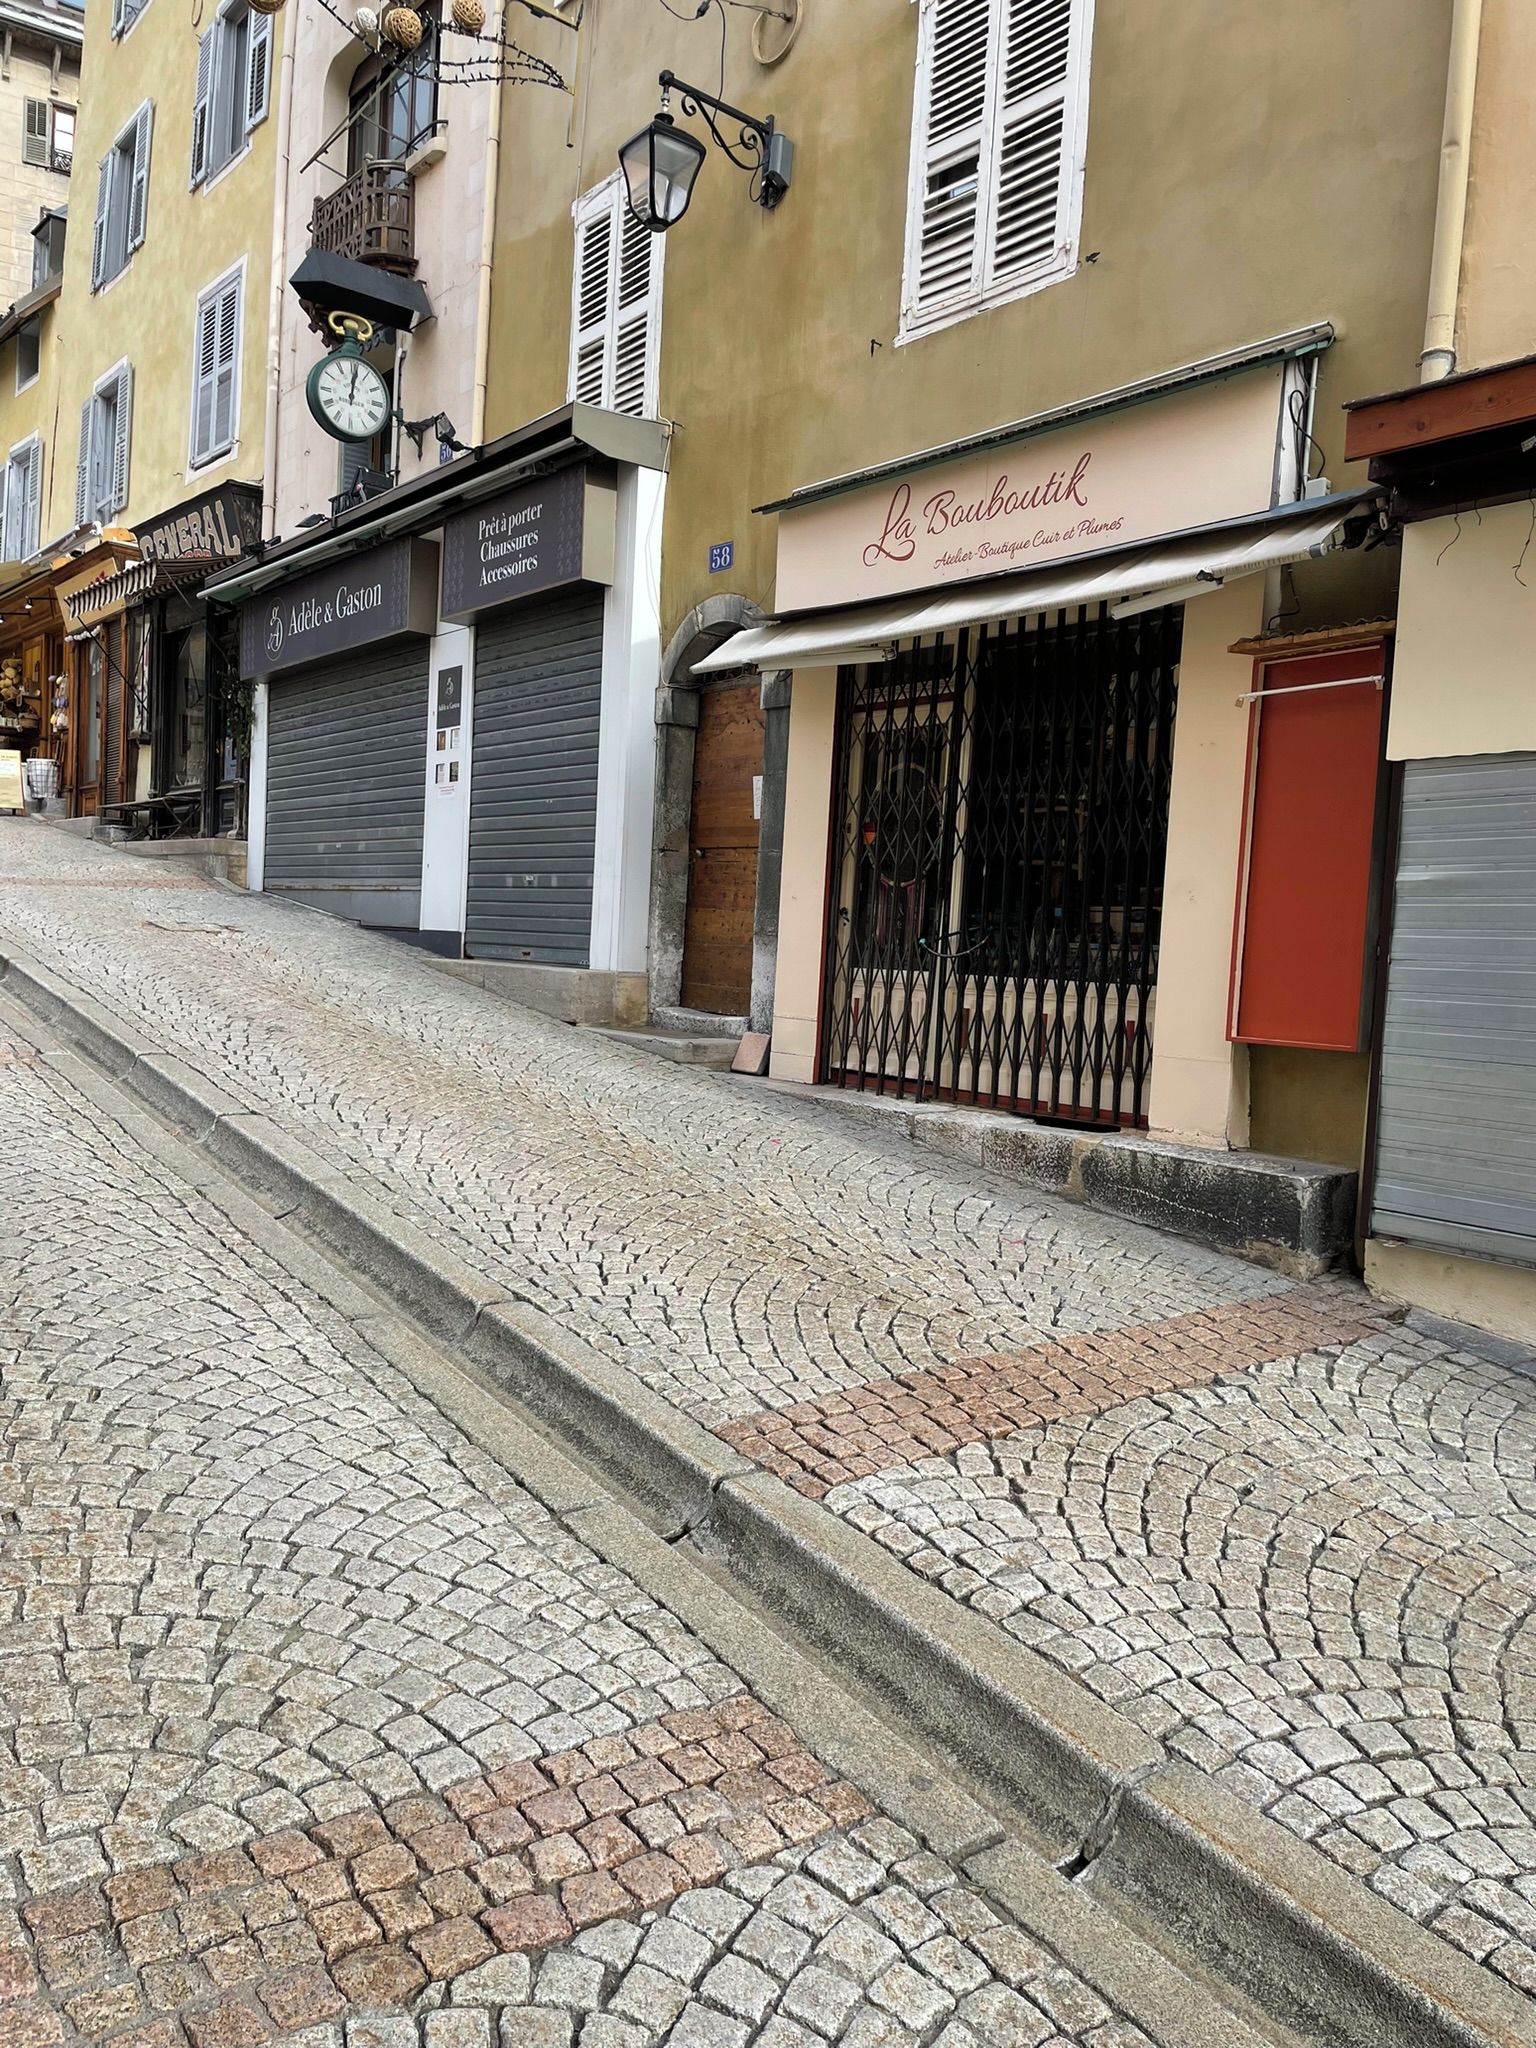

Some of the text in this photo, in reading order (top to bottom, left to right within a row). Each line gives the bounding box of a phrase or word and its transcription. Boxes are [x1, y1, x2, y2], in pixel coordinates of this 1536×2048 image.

[479, 517, 500, 541] Prêt
[508, 504, 543, 532] porter
[862, 452, 1092, 567] La Bouboutik
[480, 530, 539, 563] Chaussures
[1032, 530, 1060, 548] Cuir
[1059, 526, 1075, 542] et
[1077, 516, 1124, 538] Plumes
[479, 553, 538, 587] Accessoires
[711, 546, 730, 568] 58
[288, 582, 382, 636] Adèle & Gaston
